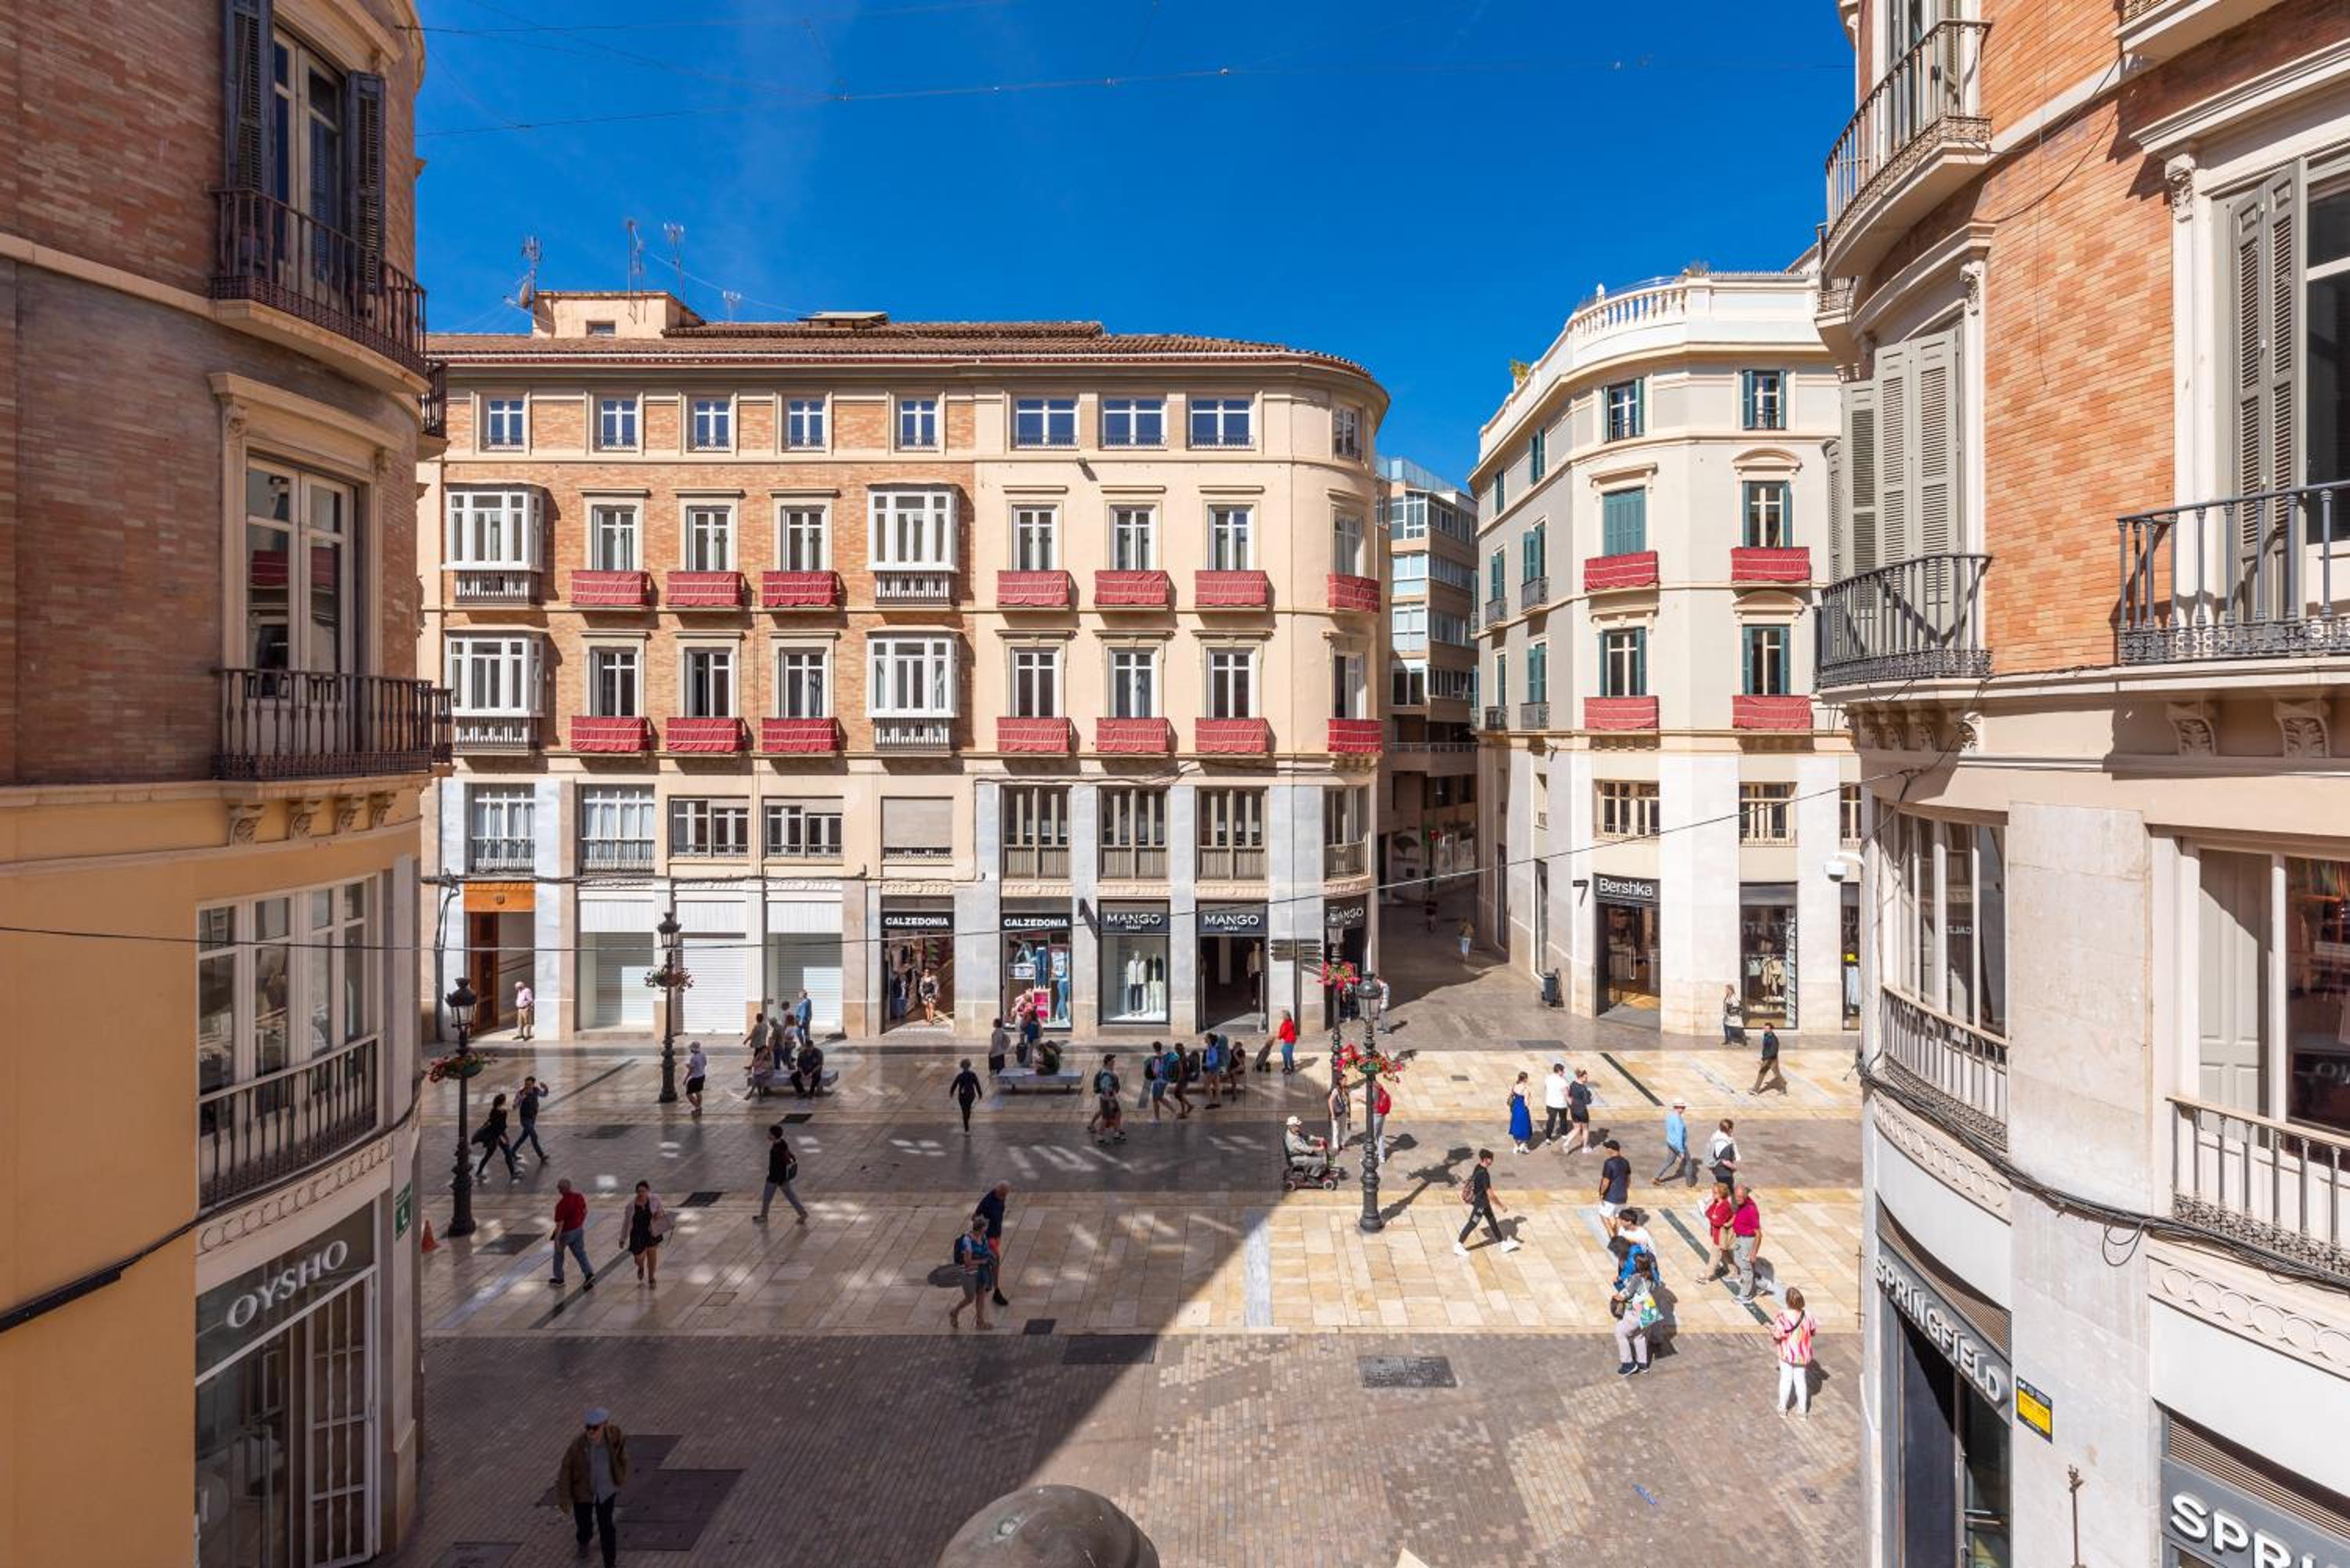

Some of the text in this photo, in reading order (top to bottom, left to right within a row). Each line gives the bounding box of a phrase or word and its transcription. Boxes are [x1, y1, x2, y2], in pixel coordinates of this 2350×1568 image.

[1599, 878, 1653, 896] Bershka
[884, 917, 949, 927] CALZEDONIA
[1003, 918, 1068, 927] CALZEDONIA
[1106, 913, 1162, 925] MANGO
[1204, 914, 1260, 925] MANGO
[226, 1240, 349, 1328] OYSHO
[1875, 1255, 2002, 1402] SPRINGFIELD
[2170, 1493, 2316, 1568] SPR
